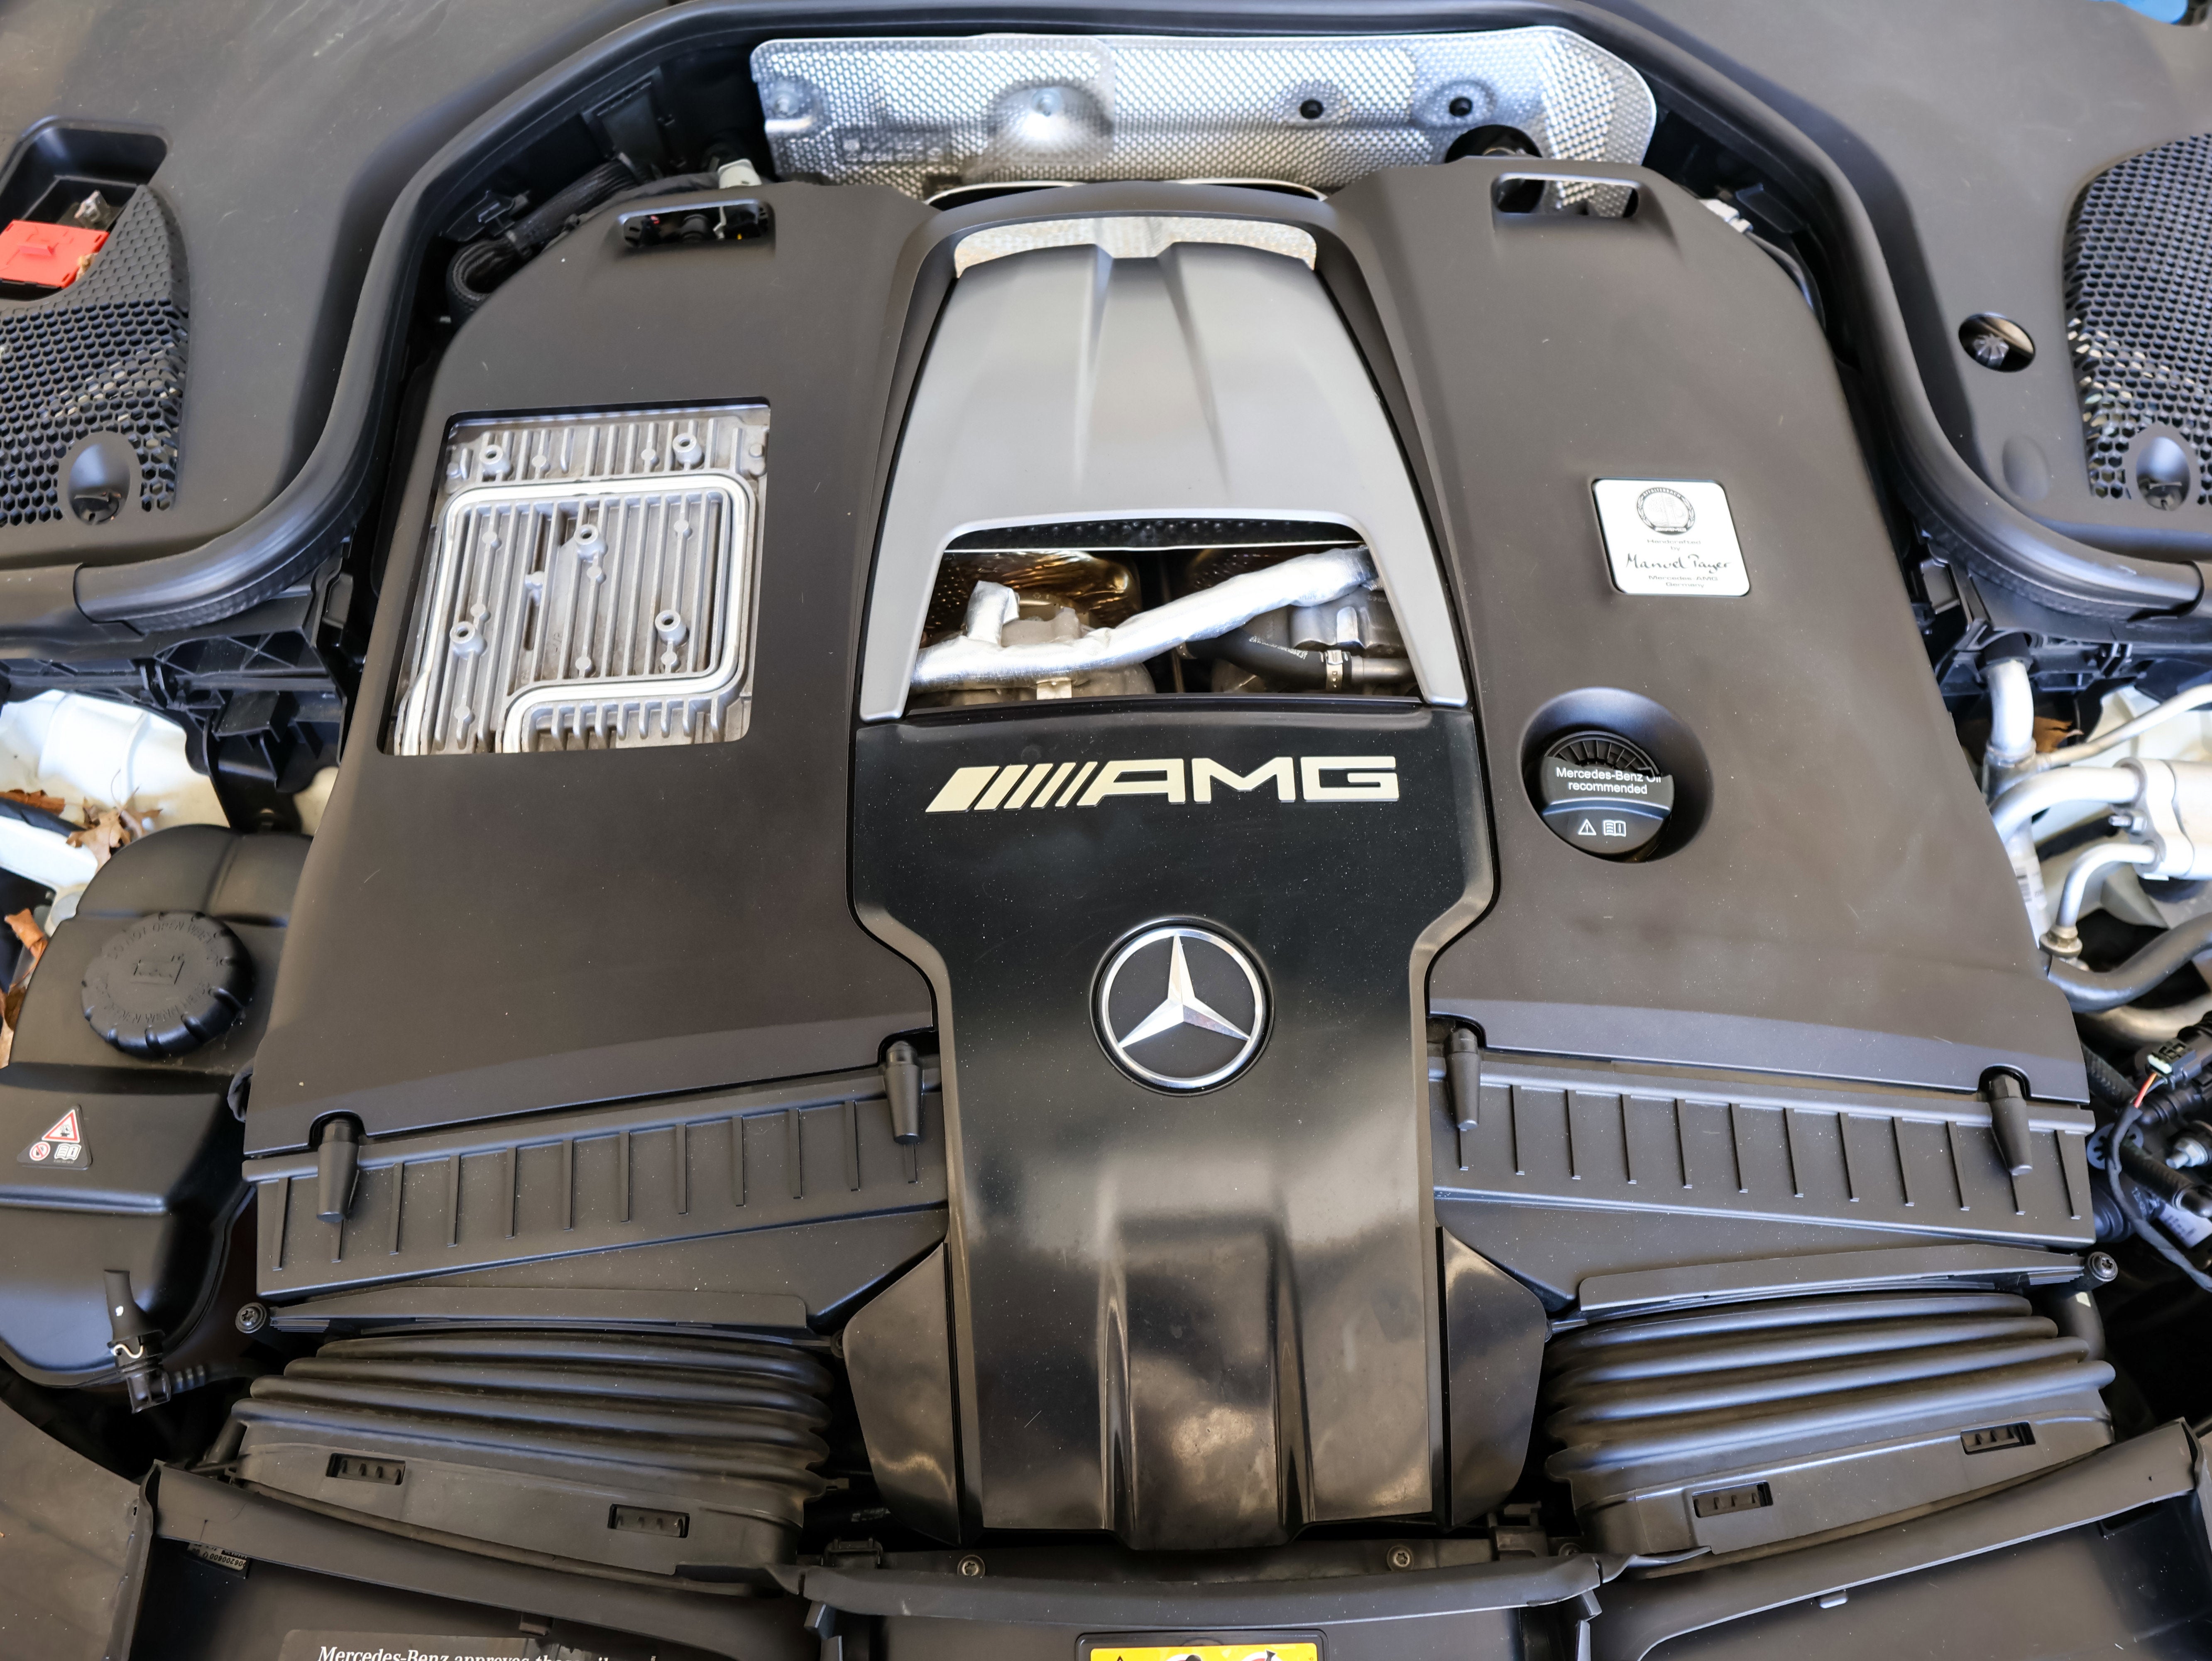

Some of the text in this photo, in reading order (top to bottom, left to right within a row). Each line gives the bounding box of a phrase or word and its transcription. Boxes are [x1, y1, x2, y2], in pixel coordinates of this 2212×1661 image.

[1077, 756, 1399, 806] AMG
[1556, 767, 1643, 782] Mercedes-Benz
[1568, 782, 1648, 795] recommended
[152, 921, 185, 932] OPEN
